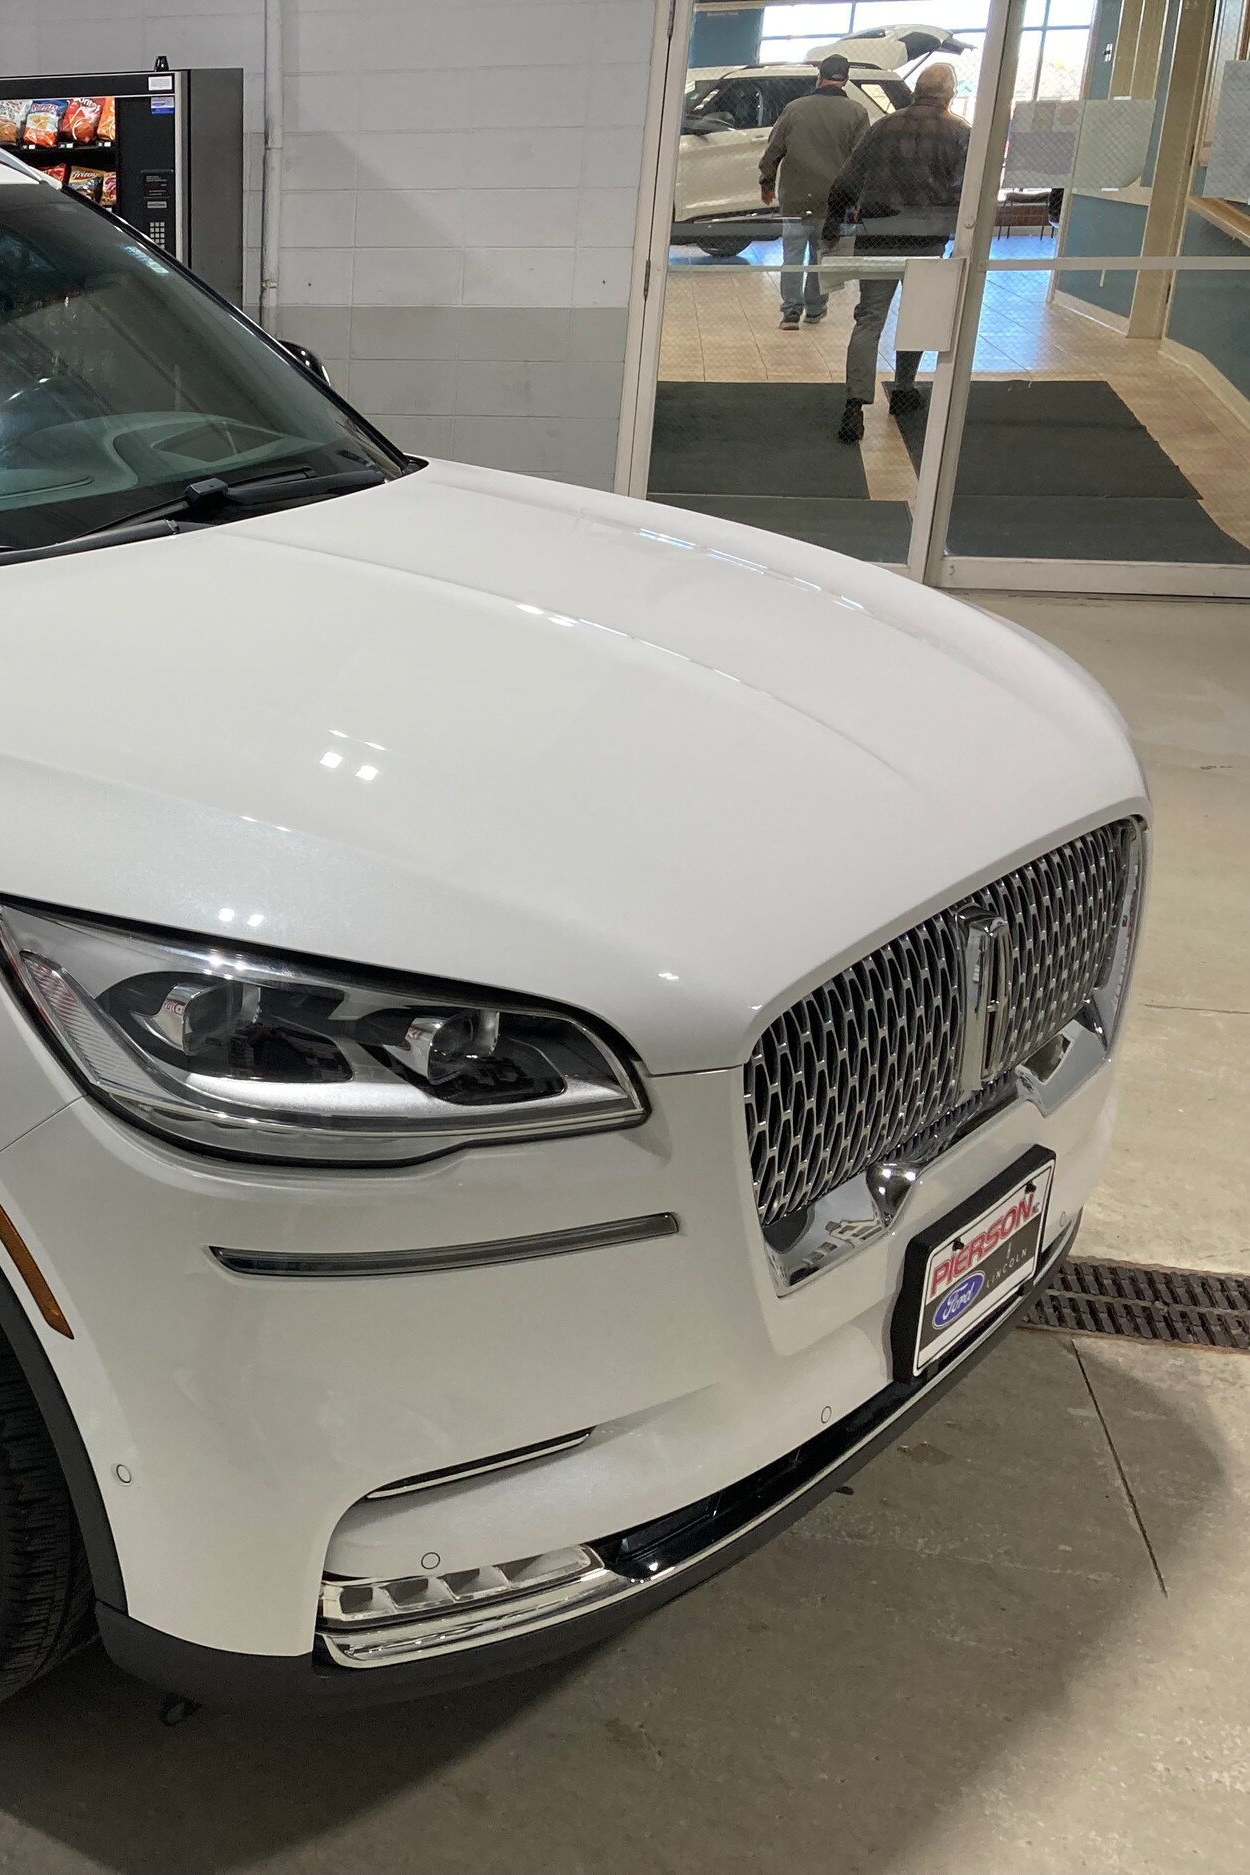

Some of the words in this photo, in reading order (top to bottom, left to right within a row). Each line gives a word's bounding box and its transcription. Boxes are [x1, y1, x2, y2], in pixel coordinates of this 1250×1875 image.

[929, 1192, 1035, 1298] PIERSON
[986, 1247, 1028, 1289] LINCOLN
[942, 1282, 975, 1320] Ford
